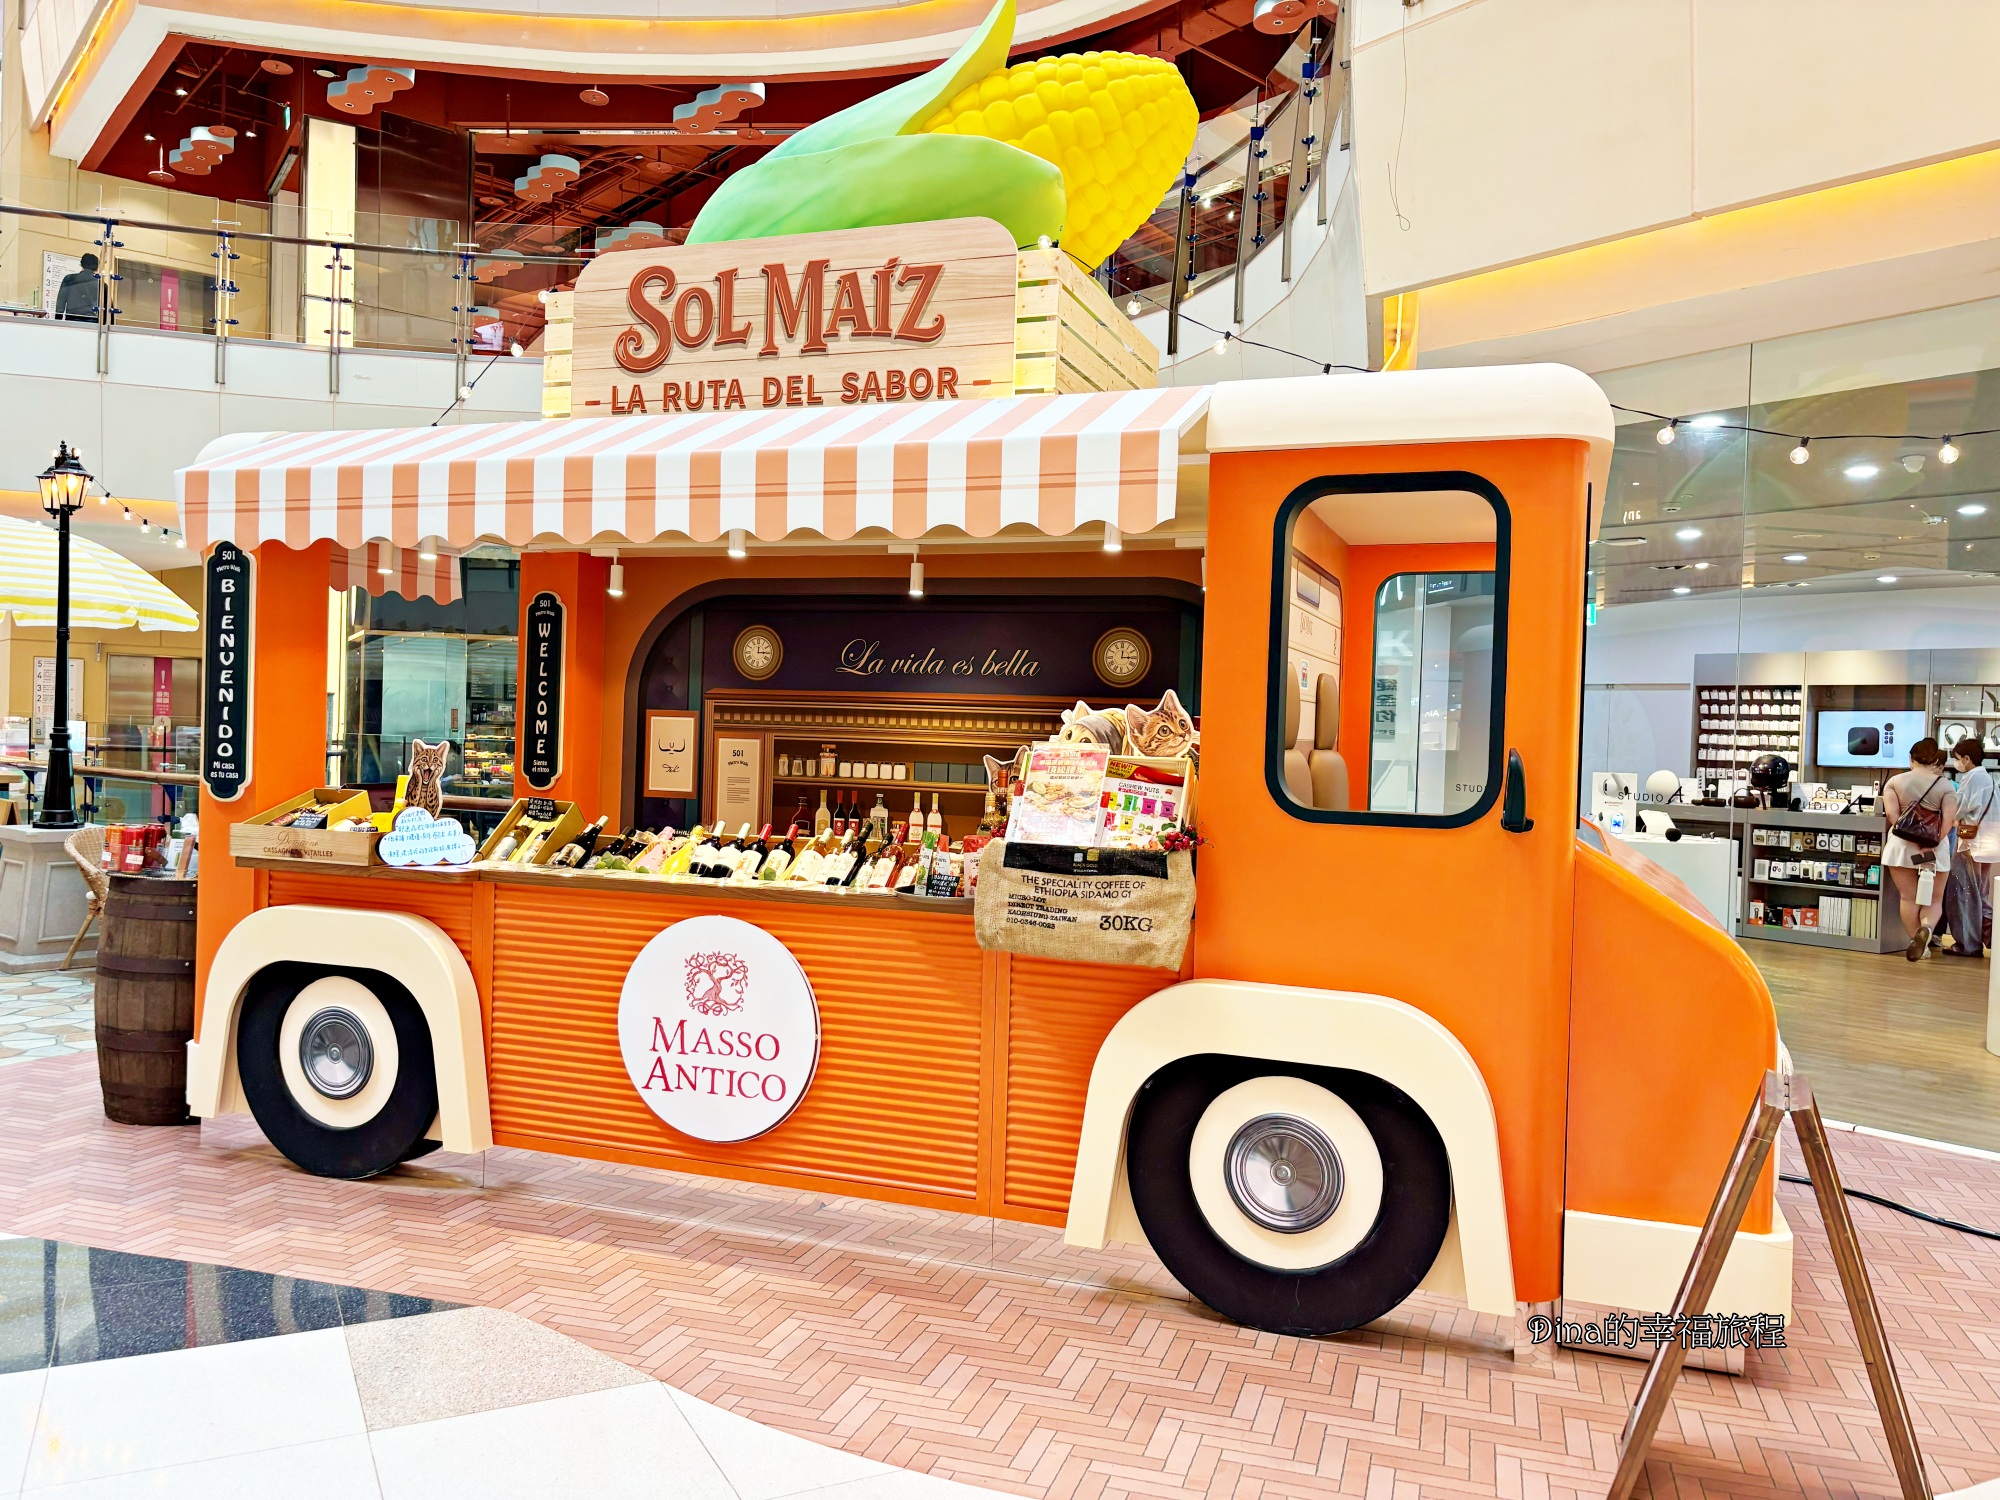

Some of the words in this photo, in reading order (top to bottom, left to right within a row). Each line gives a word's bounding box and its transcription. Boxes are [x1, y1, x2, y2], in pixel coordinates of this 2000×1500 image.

[614, 264, 752, 374] SOL
[758, 256, 946, 357] MAÍZ
[611, 384, 648, 413] LA
[662, 378, 746, 413] RUTA
[762, 374, 823, 406] DEL
[840, 366, 959, 402] SABOR
[222, 550, 236, 560] 501
[539, 599, 551, 608] 501
[835, 638, 886, 676] La
[890, 647, 947, 676] vida
[951, 655, 975, 676] es
[980, 649, 1041, 677] bella
[217, 578, 236, 757] BIENVENIDO
[535, 622, 551, 754] WELCOME
[732, 749, 744, 757] 501
[213, 761, 220, 769] Mi
[1118, 782, 1143, 790] CASHEW
[1144, 786, 1160, 794] NUTS
[1455, 783, 1485, 793] STUD
[1617, 791, 1664, 803] STUDIO
[1665, 786, 1685, 804] A
[1021, 875, 1039, 885] THE
[1041, 877, 1093, 889] SPECIALITY
[1095, 881, 1131, 890] COFFEE
[1132, 880, 1147, 890] OF
[1034, 886, 1078, 899] ETHIOPIA
[1080, 890, 1119, 899] SIDAMO
[1120, 890, 1132, 899] G1
[1007, 902, 1034, 910] DIRECT
[1035, 904, 1068, 914] TRADING
[1100, 915, 1153, 932] 30KG
[649, 1016, 781, 1062] MASSO
[641, 1056, 787, 1102] ANTICO
